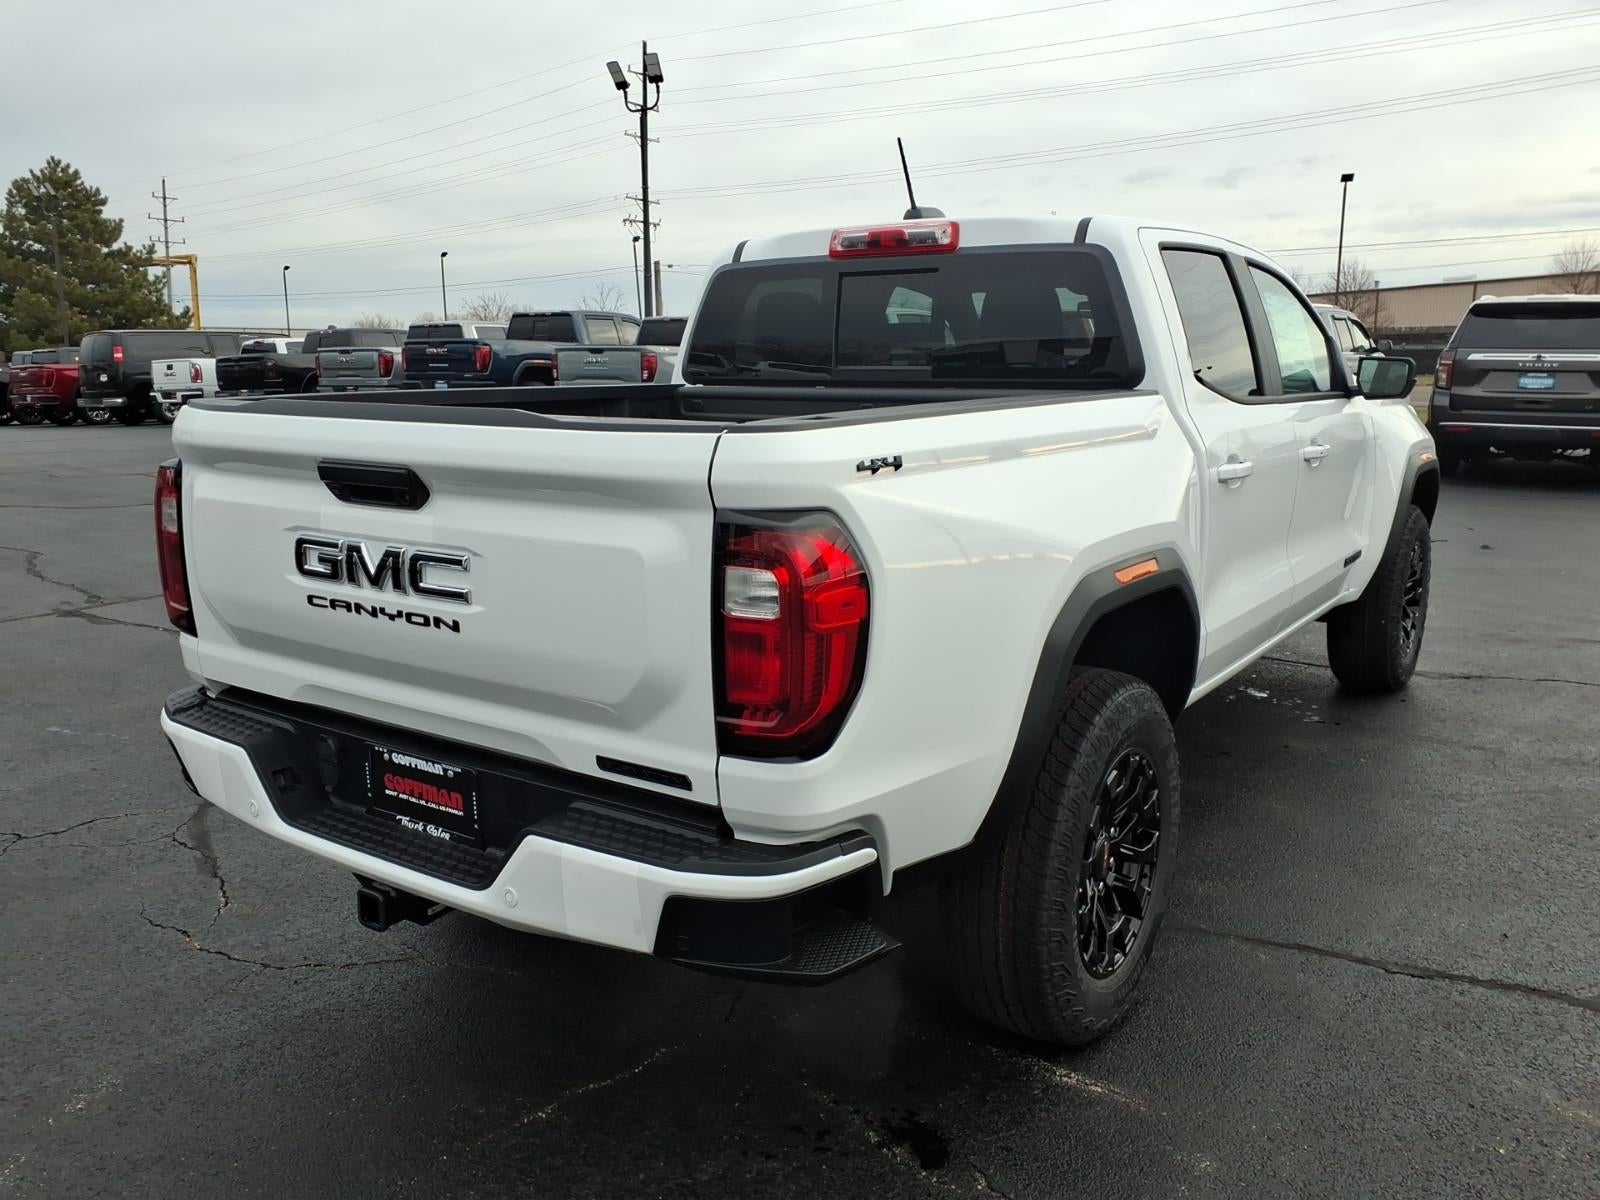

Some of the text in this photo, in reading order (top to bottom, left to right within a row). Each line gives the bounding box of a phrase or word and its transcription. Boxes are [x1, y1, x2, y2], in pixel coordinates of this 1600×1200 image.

[294, 533, 472, 606] GMC
[306, 594, 461, 633] CANYON
[391, 752, 444, 775] COFFMAN
[384, 773, 464, 811] COFFMAN
[396, 815, 424, 832] Truck
